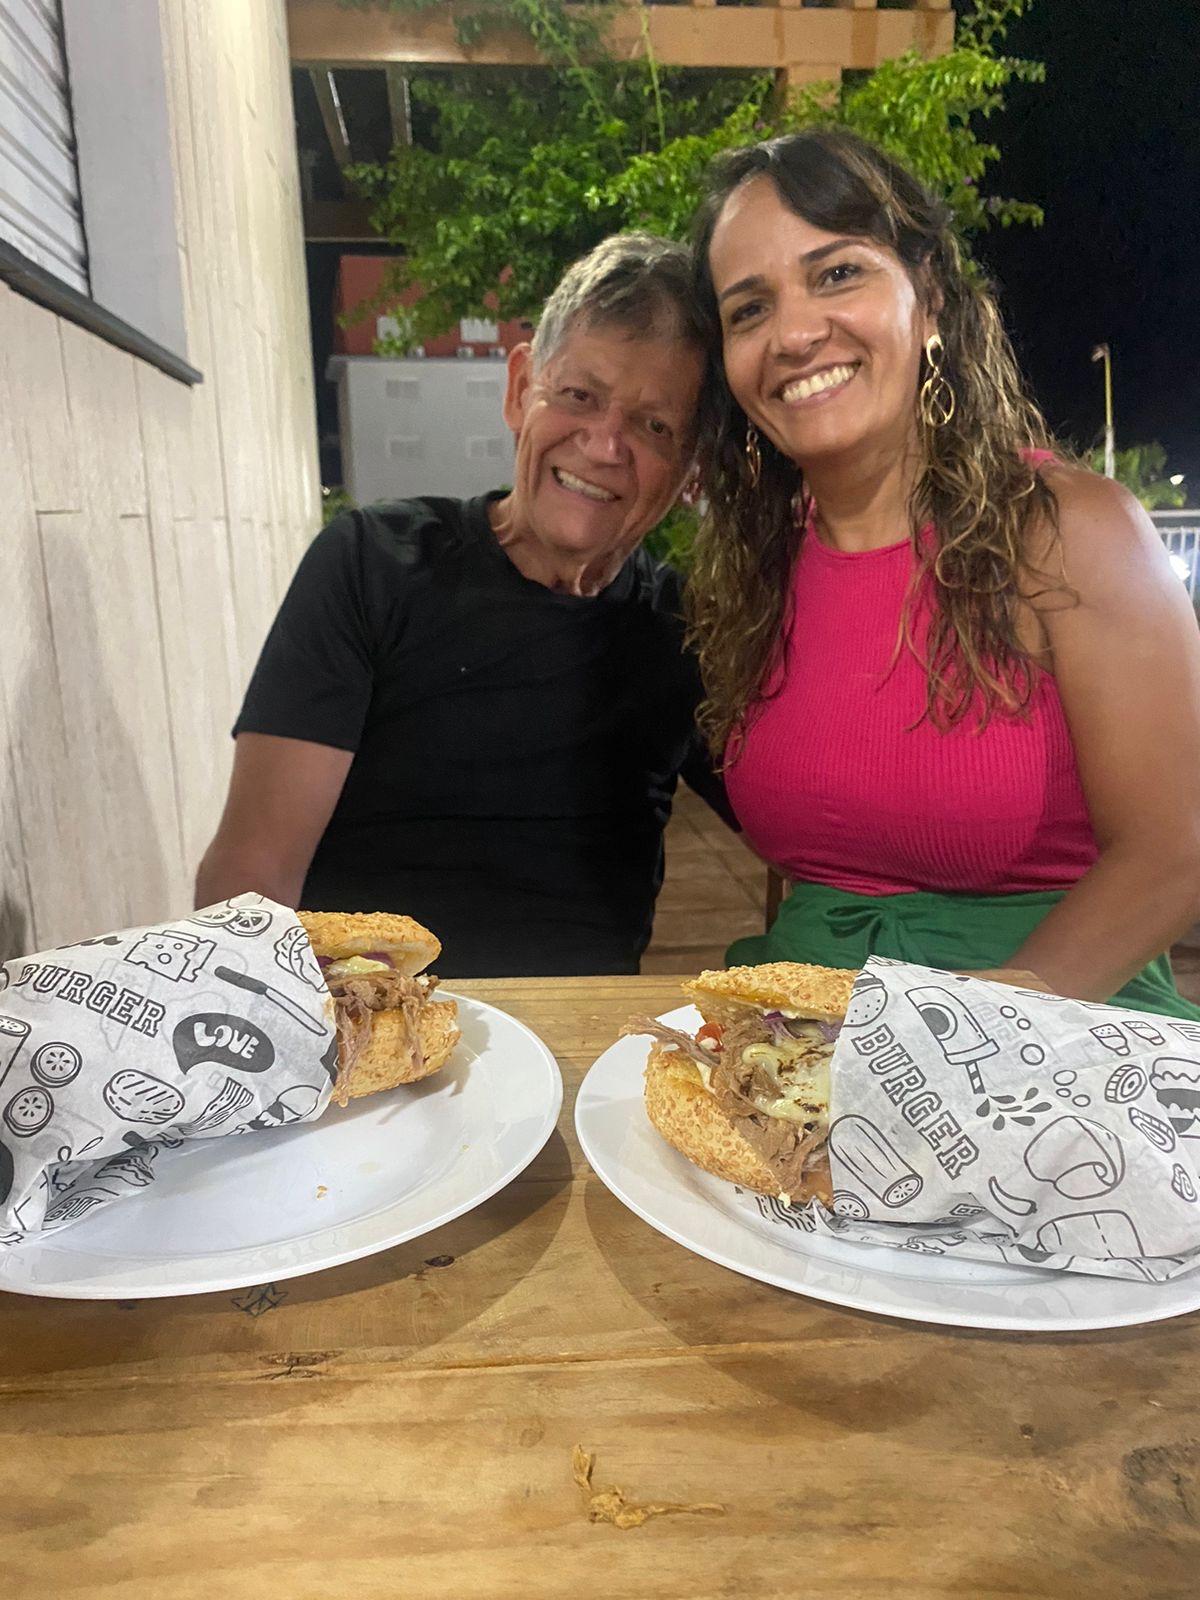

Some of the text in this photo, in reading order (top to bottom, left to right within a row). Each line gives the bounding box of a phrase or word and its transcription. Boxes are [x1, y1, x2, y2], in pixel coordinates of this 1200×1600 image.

[11, 963, 167, 1039] BURGER
[193, 1021, 260, 1060] LOVE
[850, 1022, 981, 1181] BURGER
